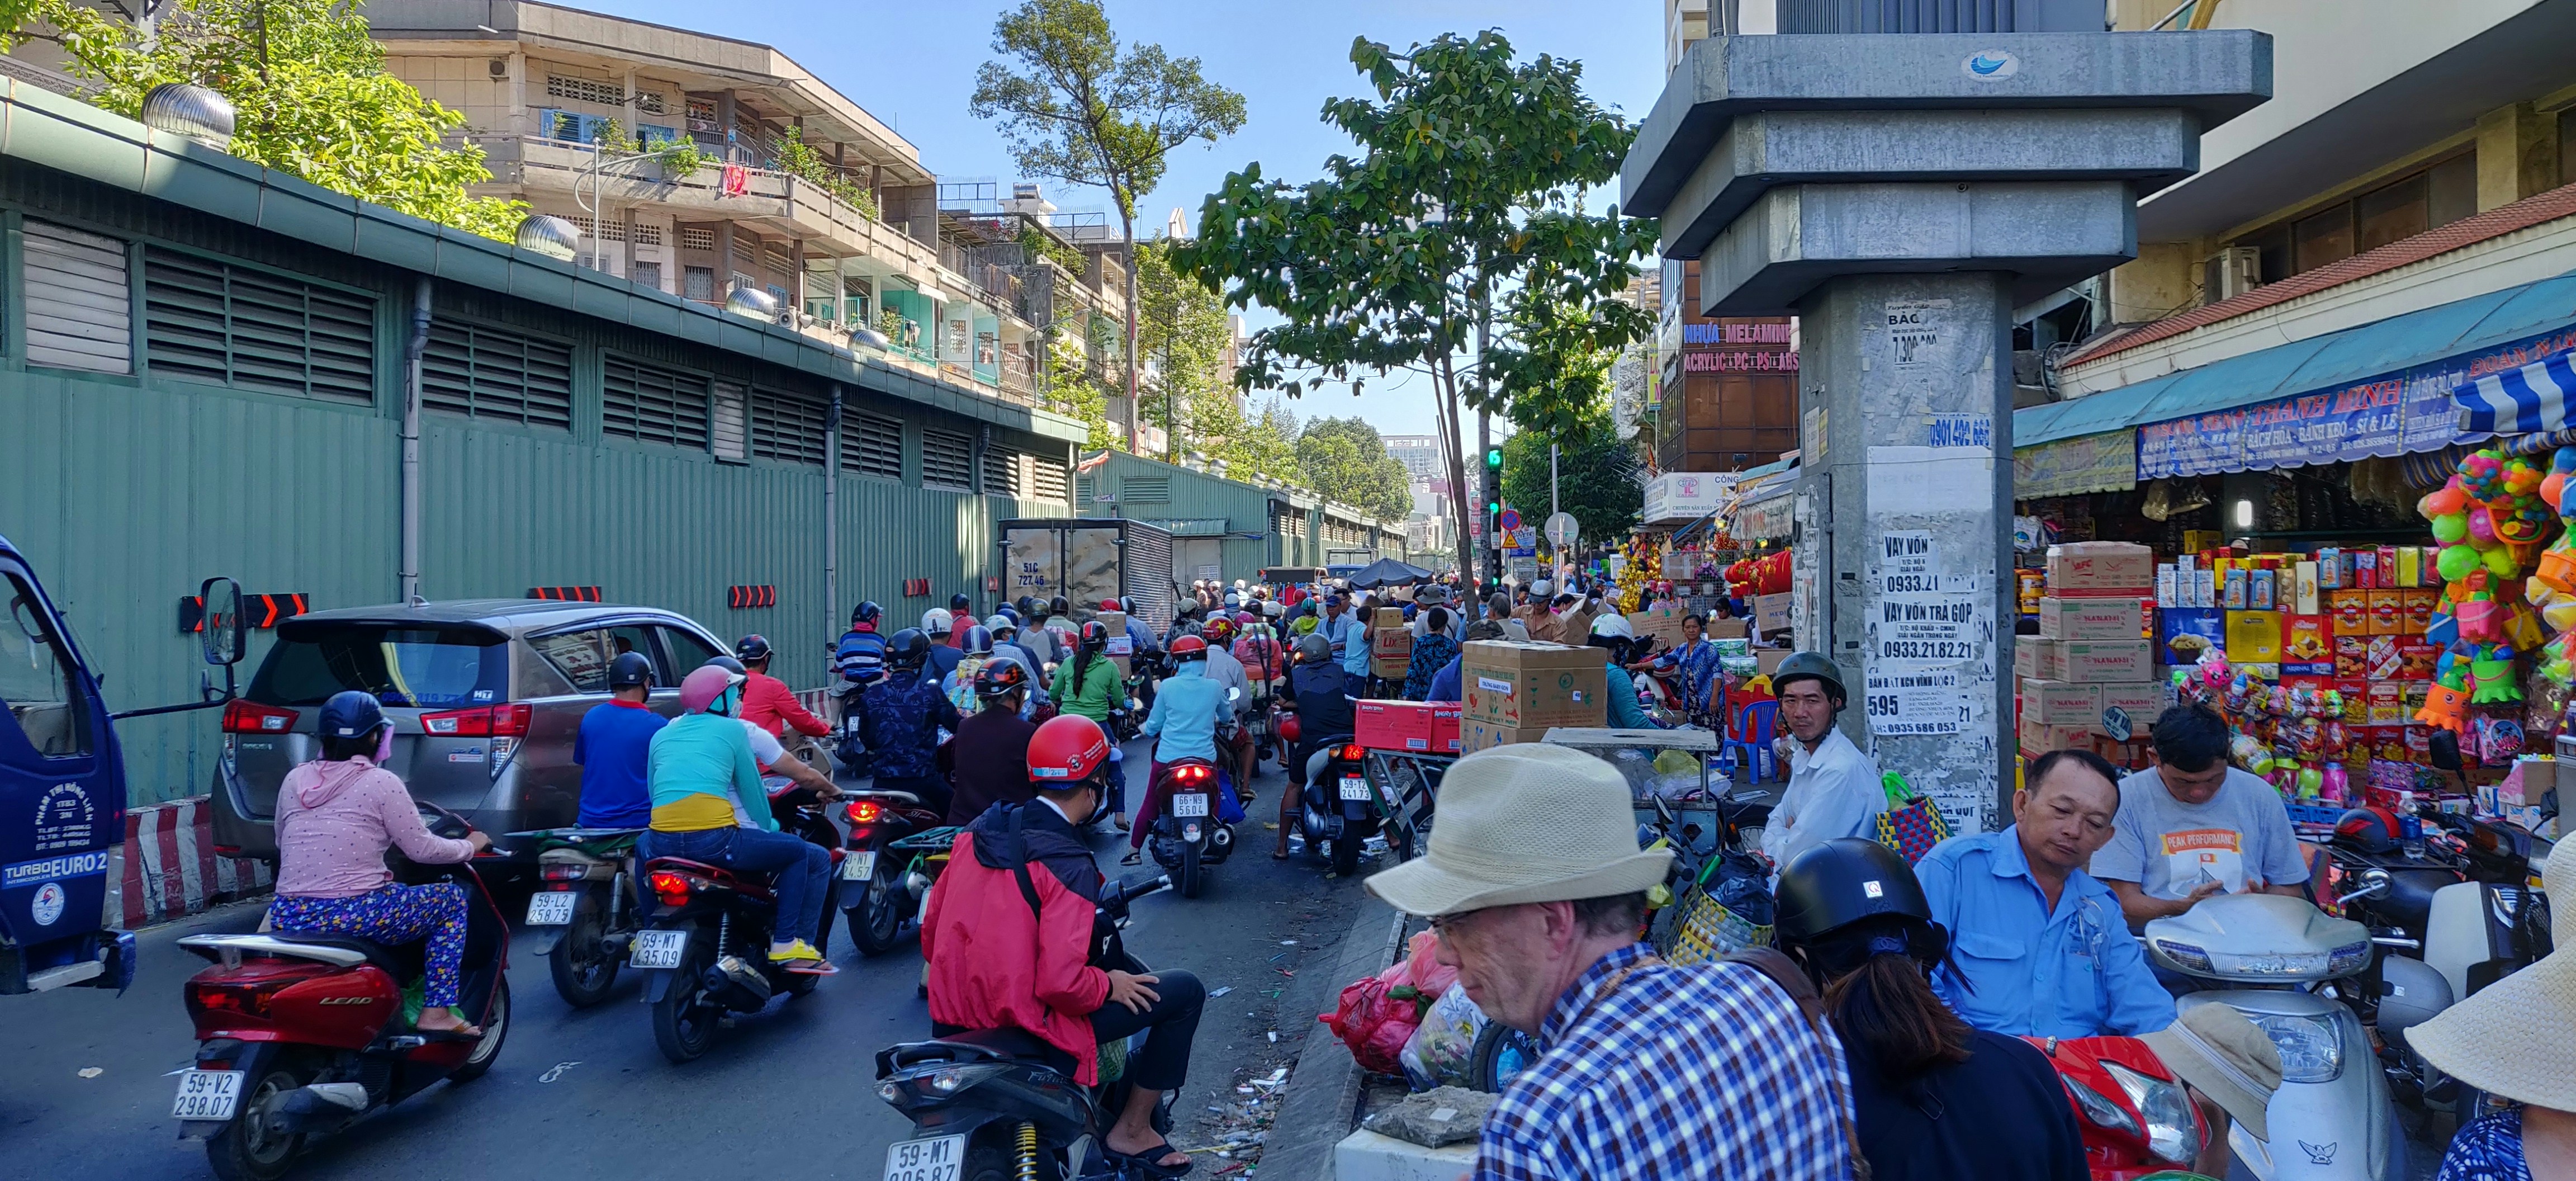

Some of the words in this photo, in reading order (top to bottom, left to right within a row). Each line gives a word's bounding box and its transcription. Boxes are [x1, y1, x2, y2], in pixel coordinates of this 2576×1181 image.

[1684, 322, 1720, 348] NHỰA
[2252, 393, 2330, 426] THANH
[2332, 379, 2403, 414] MINH
[1885, 537, 1903, 558] VAY
[1906, 534, 1928, 555] VỐN
[1024, 563, 1038, 572] 51C
[1884, 601, 1902, 623] VAY
[1905, 601, 1926, 621] VỐN
[1929, 599, 1948, 621] TRẢ
[1952, 598, 1972, 623] GÓP
[1884, 641, 1971, 658] 0933.21.82.21
[1950, 675, 1955, 686] 2
[1868, 695, 1898, 716] 595
[1937, 722, 1956, 732] 053
[1344, 780, 1366, 789] 59-T2
[1179, 796, 1202, 805] 66-N9
[1342, 789, 1369, 799] 241.73
[1179, 805, 1203, 815] 5604
[2167, 837, 2186, 848] PEAK
[5, 862, 51, 879] TURBO
[51, 854, 94, 877] EURO
[97, 853, 107, 870] 2
[537, 895, 568, 908] 59-L2
[643, 934, 675, 948] 59-M1
[187, 1074, 233, 1094] 59-V2
[174, 1097, 233, 1116] 298.07
[899, 1140, 950, 1169] 59-M1
